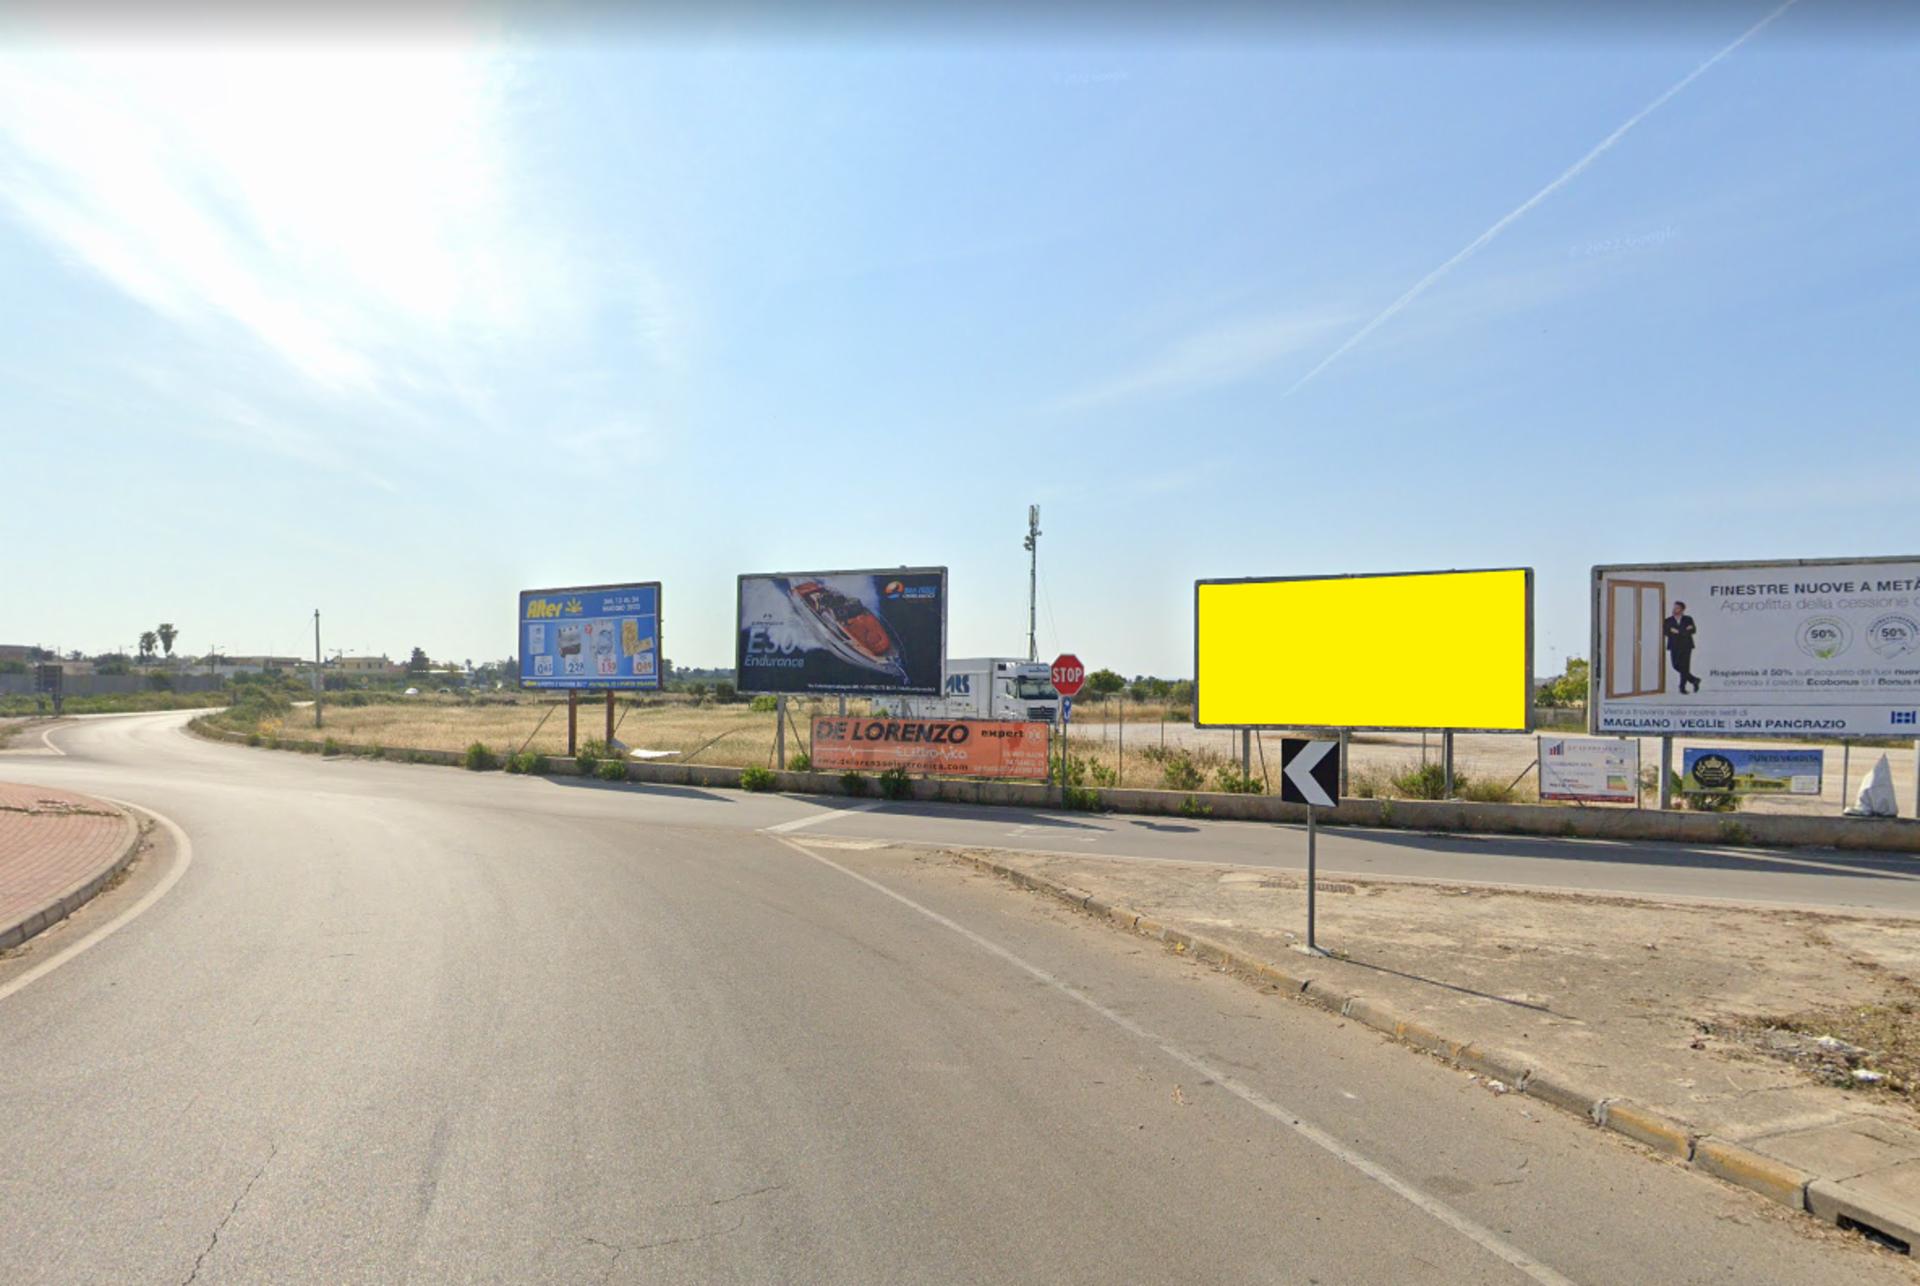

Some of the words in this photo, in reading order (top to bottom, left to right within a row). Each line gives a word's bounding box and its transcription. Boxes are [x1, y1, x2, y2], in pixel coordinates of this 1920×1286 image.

[1710, 583, 1789, 597] FINESTRE
[1794, 581, 1854, 595] NUOVE
[1860, 581, 1872, 592] A
[1719, 598, 1791, 613] Approfitta
[1796, 597, 1833, 610] della
[1837, 596, 1909, 609] cessione
[1810, 629, 1837, 639] 50%
[1881, 627, 1907, 638] 50%
[744, 655, 805, 667] Endurance
[1052, 668, 1083, 683] STOP
[1806, 678, 1860, 686] Ecobonus
[1603, 718, 1671, 728] MAGLIANO
[1680, 718, 1725, 728] VEGLIE
[1734, 719, 1762, 729] SAN
[1765, 720, 1847, 729] PANCRAZIO
[816, 719, 848, 741] DE
[851, 721, 969, 744] LORENZO
[981, 728, 1024, 739] expert
